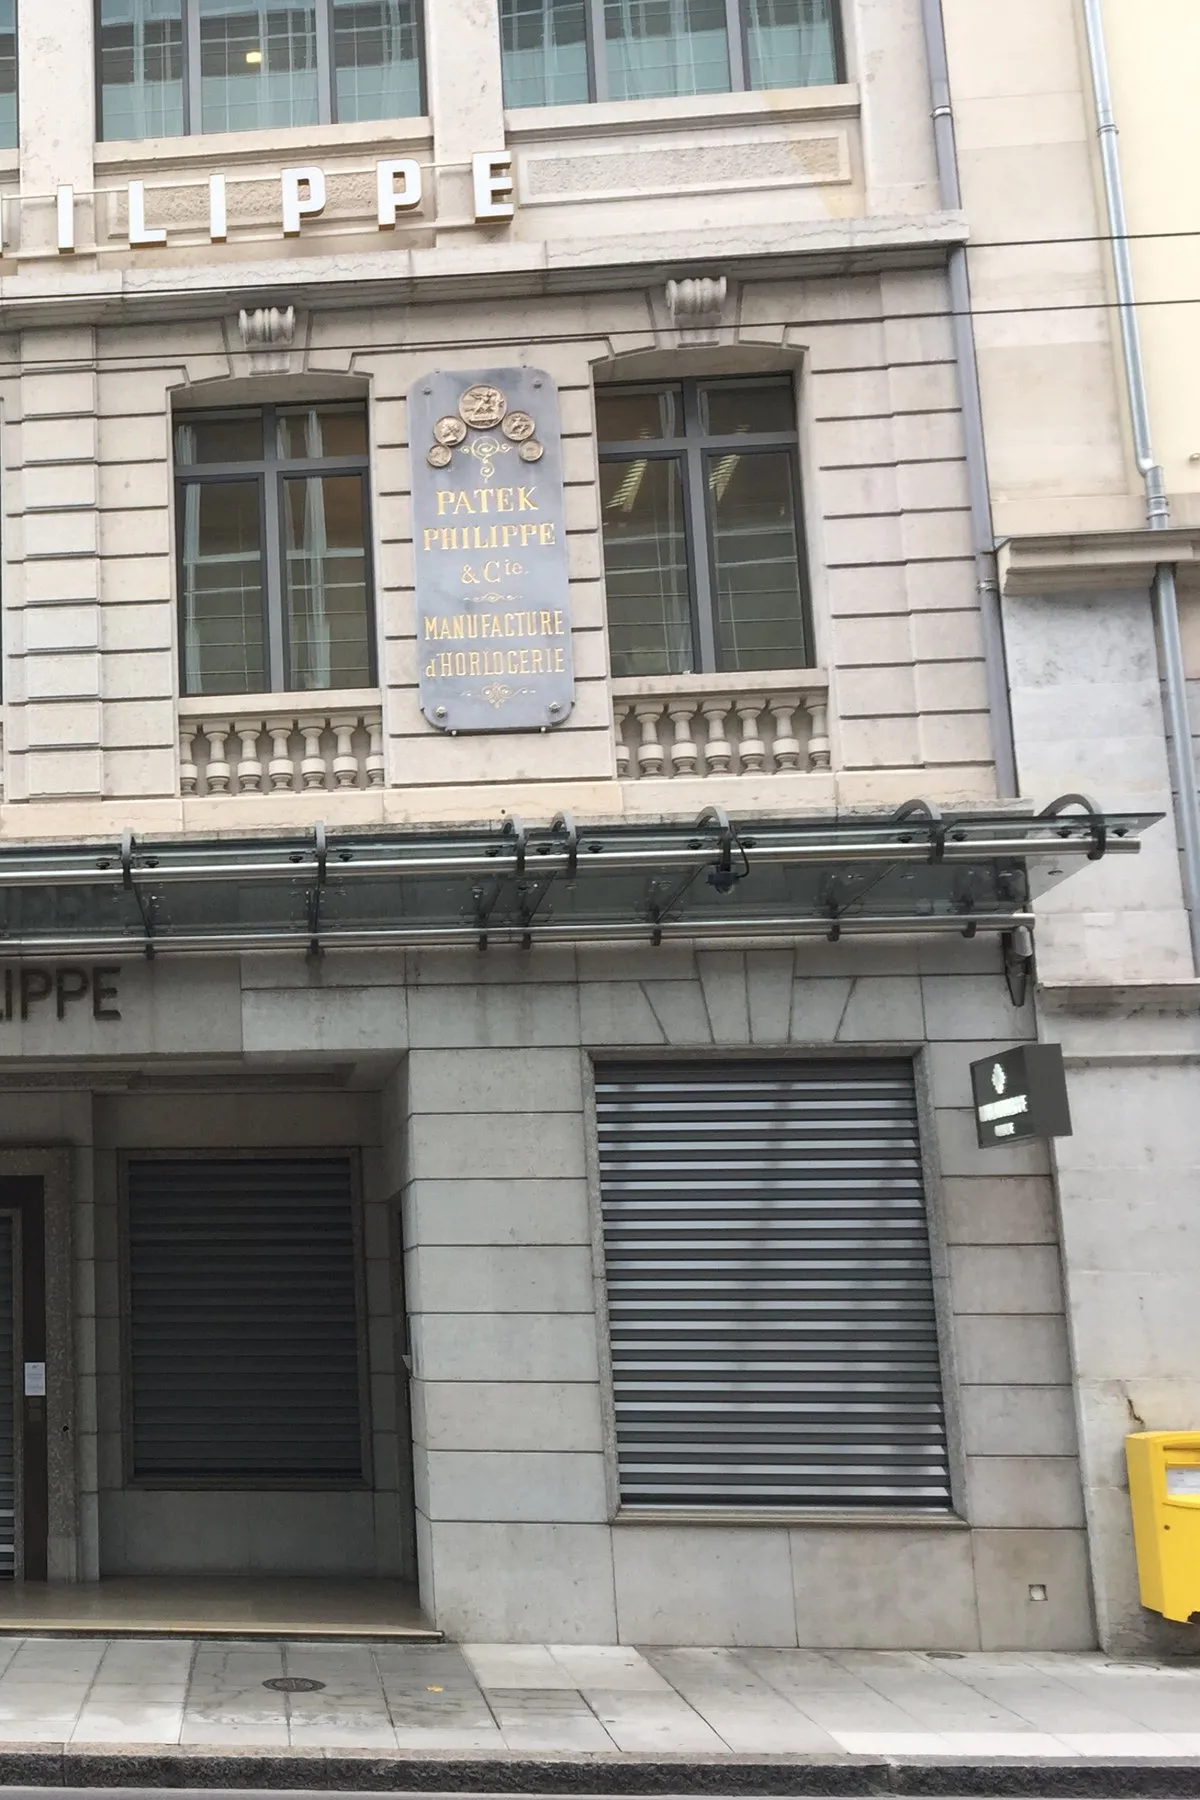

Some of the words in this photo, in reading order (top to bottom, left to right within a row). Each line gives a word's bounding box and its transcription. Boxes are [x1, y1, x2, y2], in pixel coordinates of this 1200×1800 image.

[436, 486, 539, 516] PATEK
[423, 522, 556, 551] PHILIPPE
[424, 610, 565, 641] MANUFACTURE
[425, 648, 566, 677] d'HORLOGERIE
